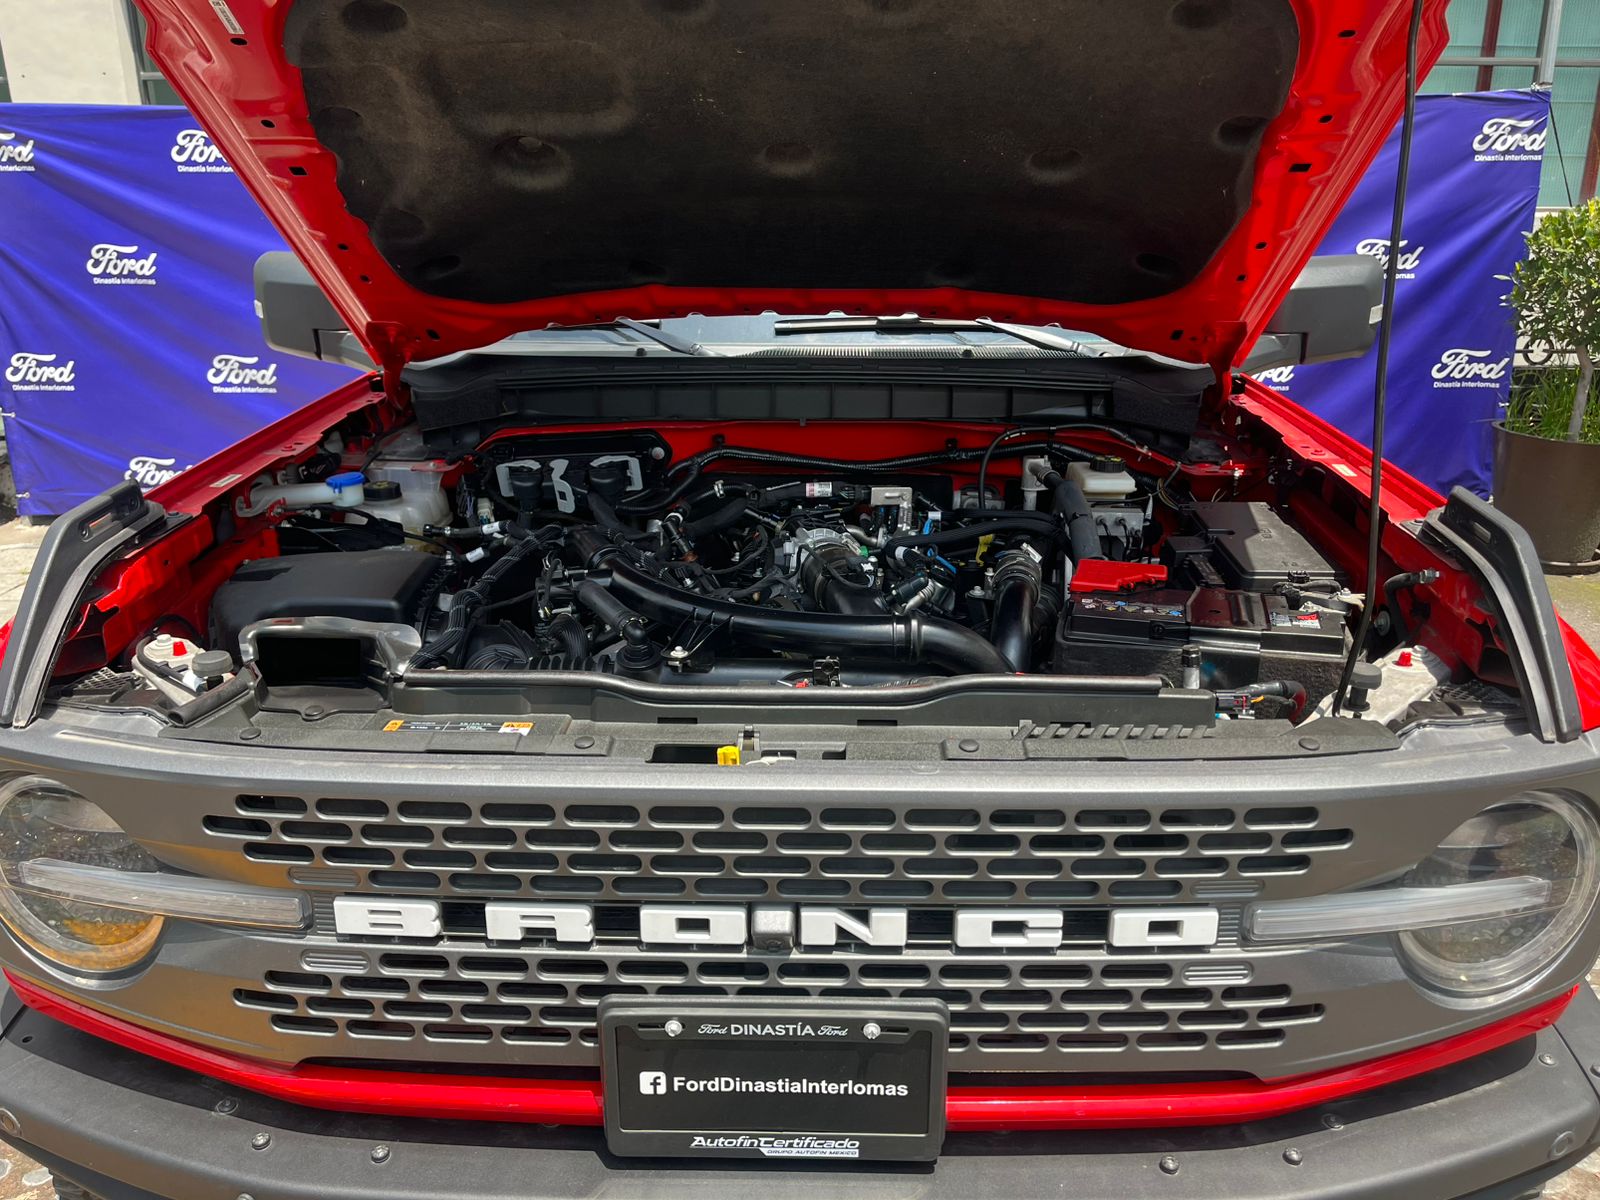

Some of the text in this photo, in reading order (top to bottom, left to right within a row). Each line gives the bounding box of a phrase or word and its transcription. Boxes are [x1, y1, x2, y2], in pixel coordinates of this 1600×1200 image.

[0, 132, 35, 162] rd
[171, 129, 227, 163] For
[1472, 118, 1548, 151] Ford
[86, 243, 157, 276] Ford
[5, 352, 75, 383] Ford
[206, 354, 278, 385] Ford
[1431, 349, 1510, 379] Ford
[124, 456, 193, 486] For
[333, 896, 1219, 948] BRONCO
[698, 1022, 848, 1036] Ford DINASTÍA Ford
[673, 1077, 909, 1097] FordDinastiaInterlomas
